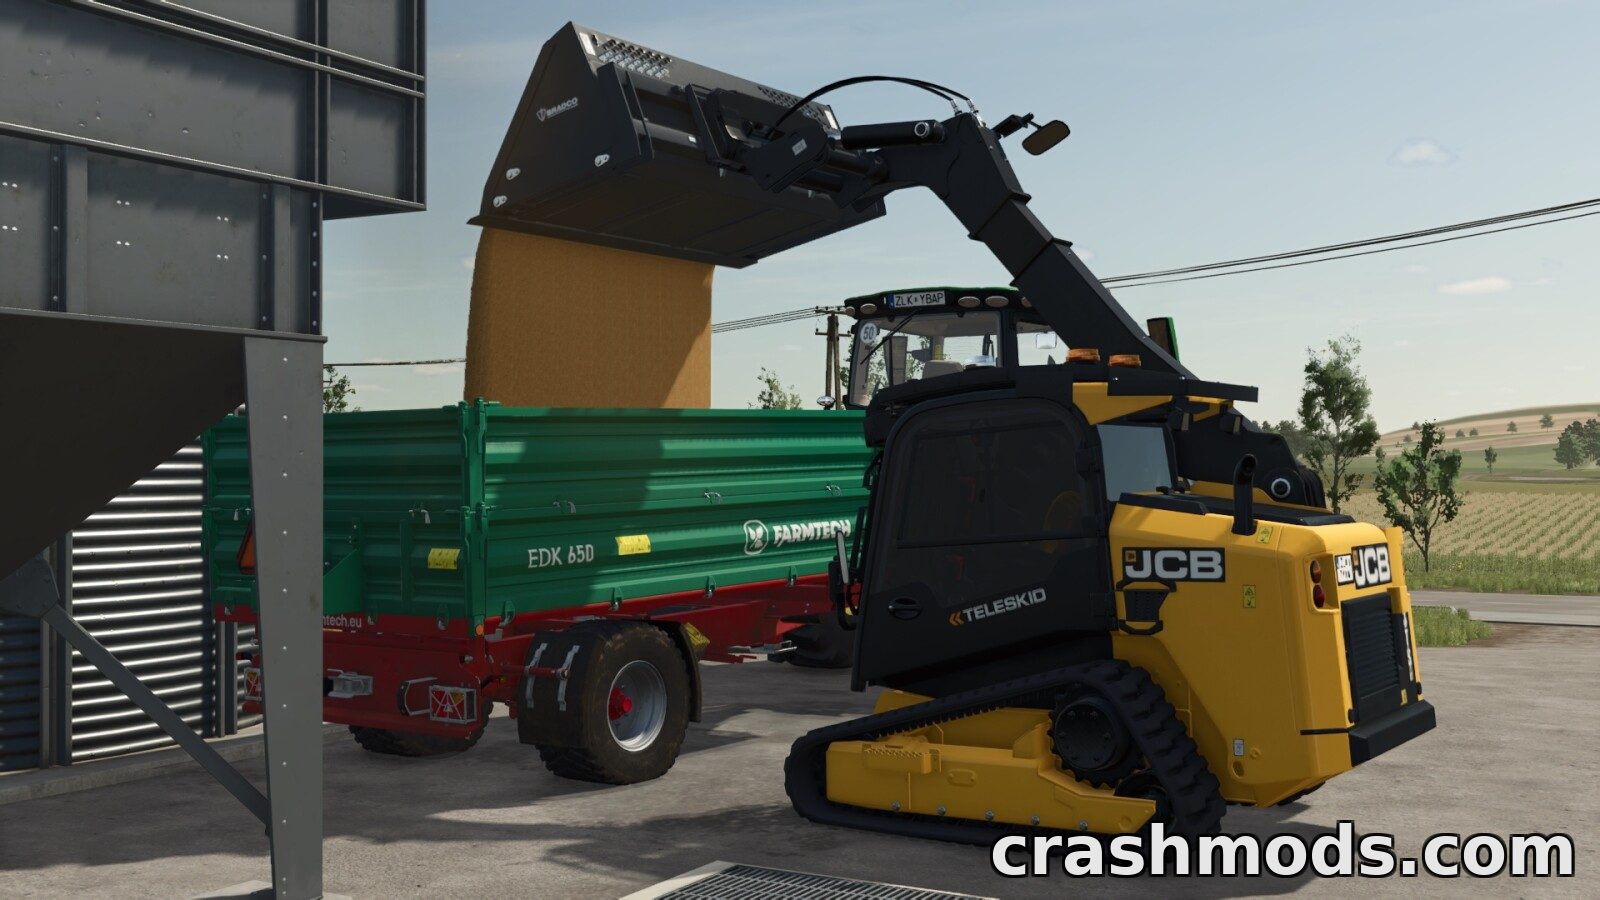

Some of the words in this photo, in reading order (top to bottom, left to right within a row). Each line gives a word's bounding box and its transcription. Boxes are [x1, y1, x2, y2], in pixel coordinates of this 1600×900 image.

[895, 295, 914, 307] ZLK
[920, 292, 944, 305] YBAP
[863, 326, 875, 341] 50
[772, 519, 852, 547] FARMTECH
[527, 546, 563, 568] EDK
[567, 544, 594, 564] 650
[1124, 549, 1224, 579] JCB
[1354, 545, 1392, 587] JCB
[962, 587, 1047, 622] TELESKID
